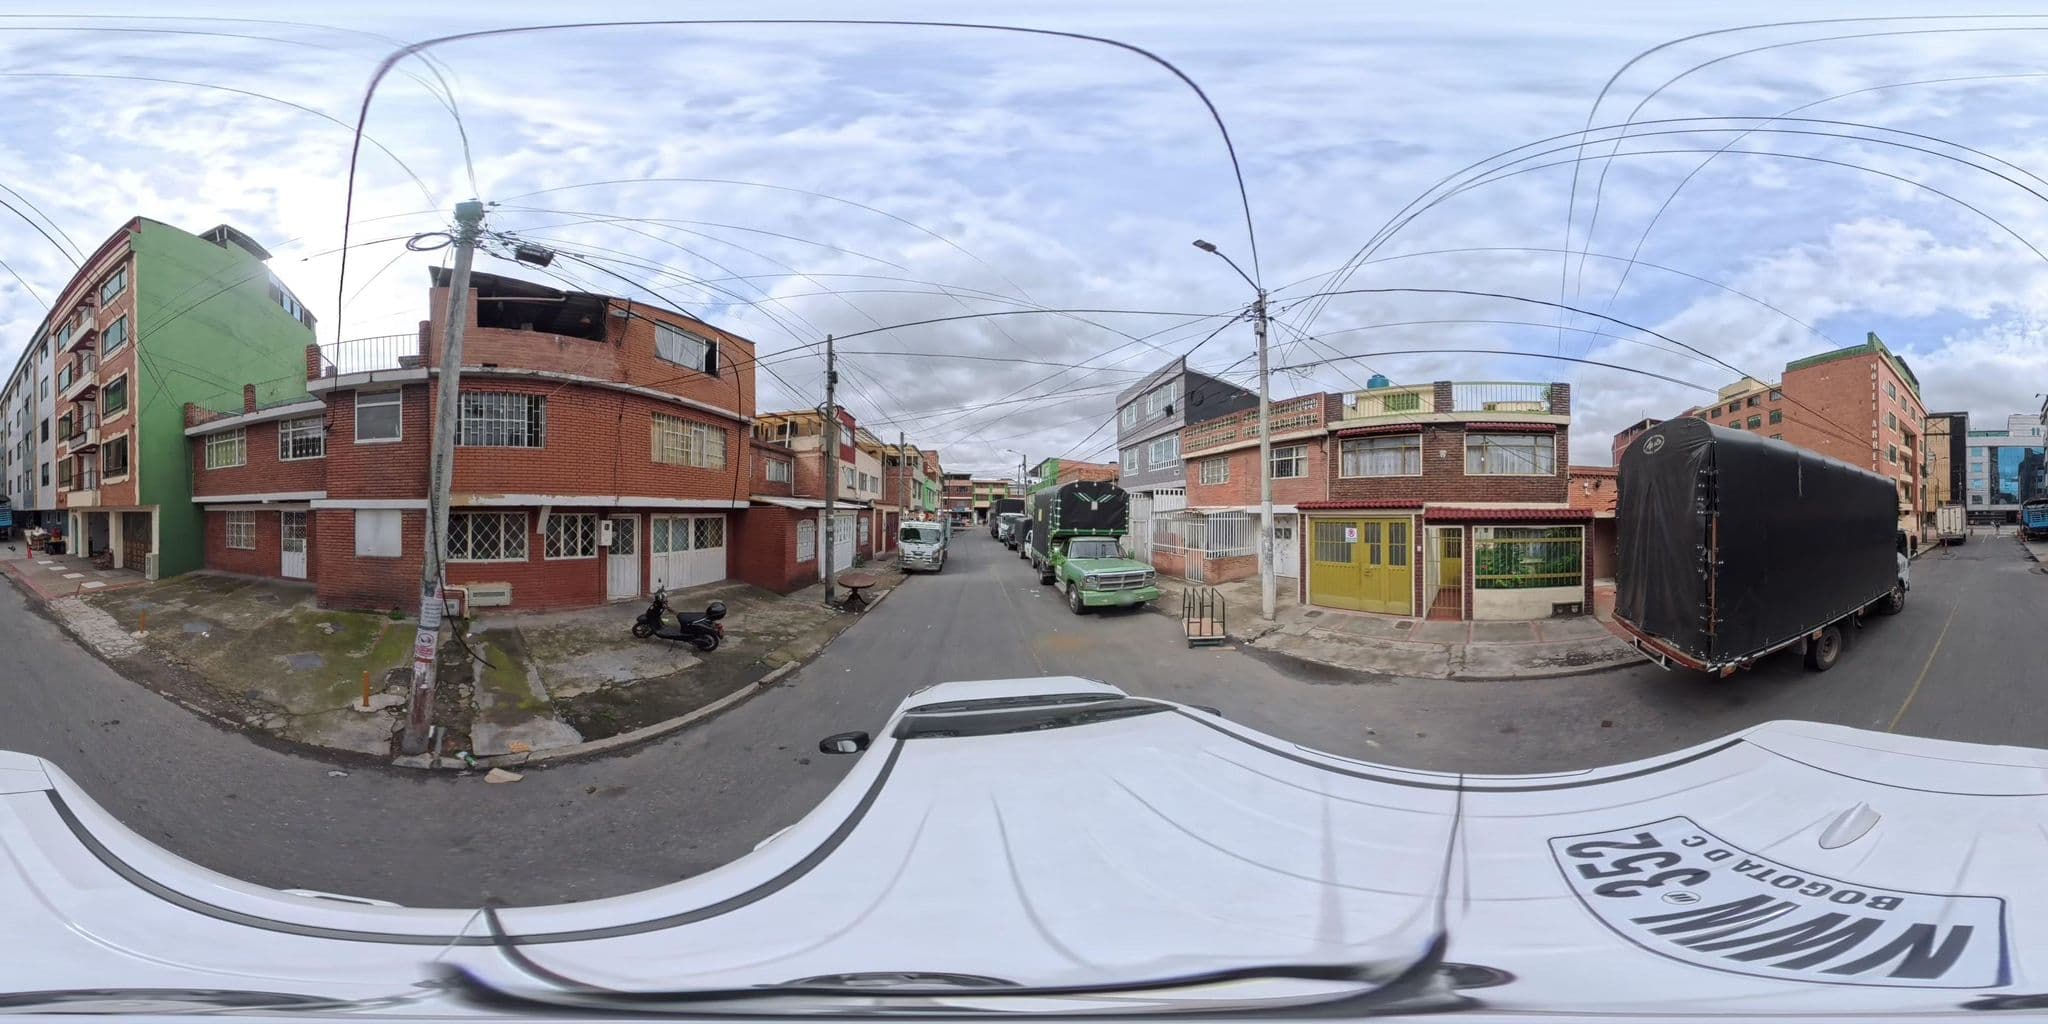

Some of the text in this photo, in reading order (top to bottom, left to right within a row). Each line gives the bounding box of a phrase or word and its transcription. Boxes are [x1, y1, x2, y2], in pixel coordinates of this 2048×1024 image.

[1566, 832, 1974, 979] NWW 352
[1681, 836, 1904, 911] BOGOTA D C
